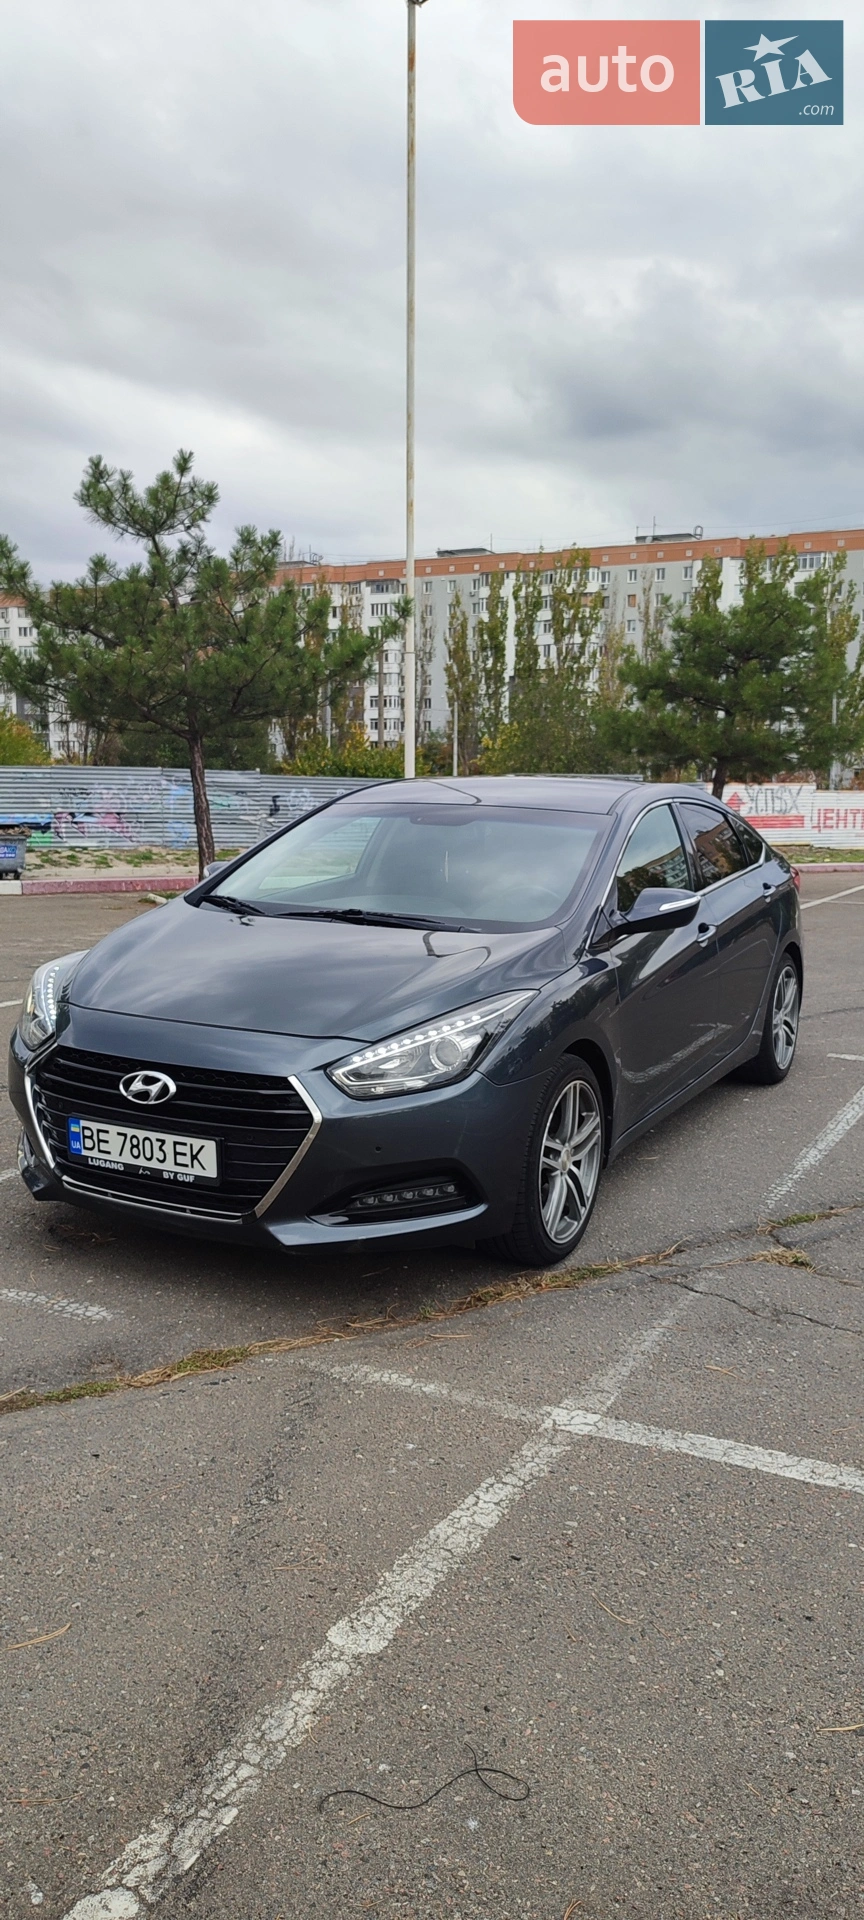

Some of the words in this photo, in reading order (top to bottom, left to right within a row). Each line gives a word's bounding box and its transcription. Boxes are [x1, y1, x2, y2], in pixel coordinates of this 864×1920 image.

[71, 1140, 81, 1149] UA
[82, 1126, 111, 1155] BE
[116, 1132, 167, 1163] 7803
[173, 1141, 206, 1171] EK
[162, 1171, 175, 1180] BY
